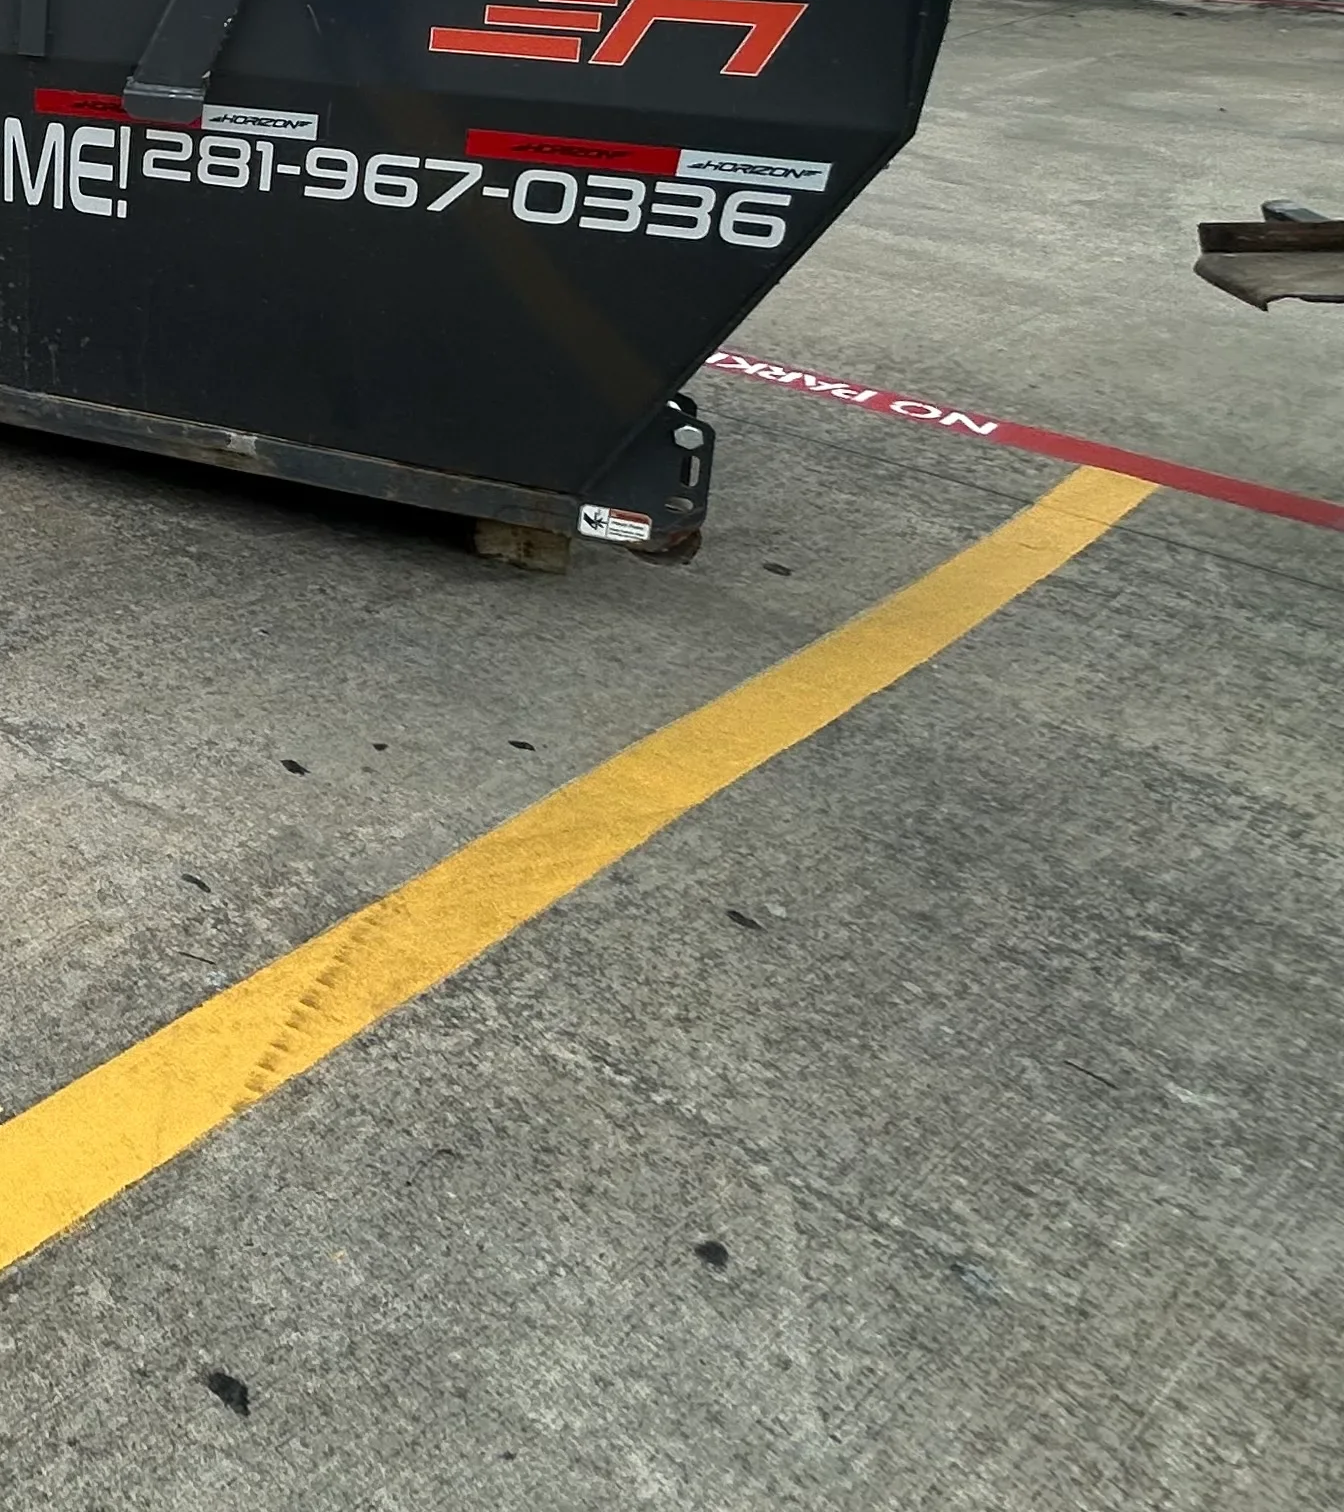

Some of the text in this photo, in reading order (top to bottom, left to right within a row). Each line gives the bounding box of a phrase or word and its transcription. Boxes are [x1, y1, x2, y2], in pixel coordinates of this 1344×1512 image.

[208, 113, 312, 130] HORIZON
[4, 117, 131, 218] ME!
[688, 158, 823, 182] HORIZON
[142, 128, 792, 248] 281-967-0336
[889, 400, 999, 435] NO
